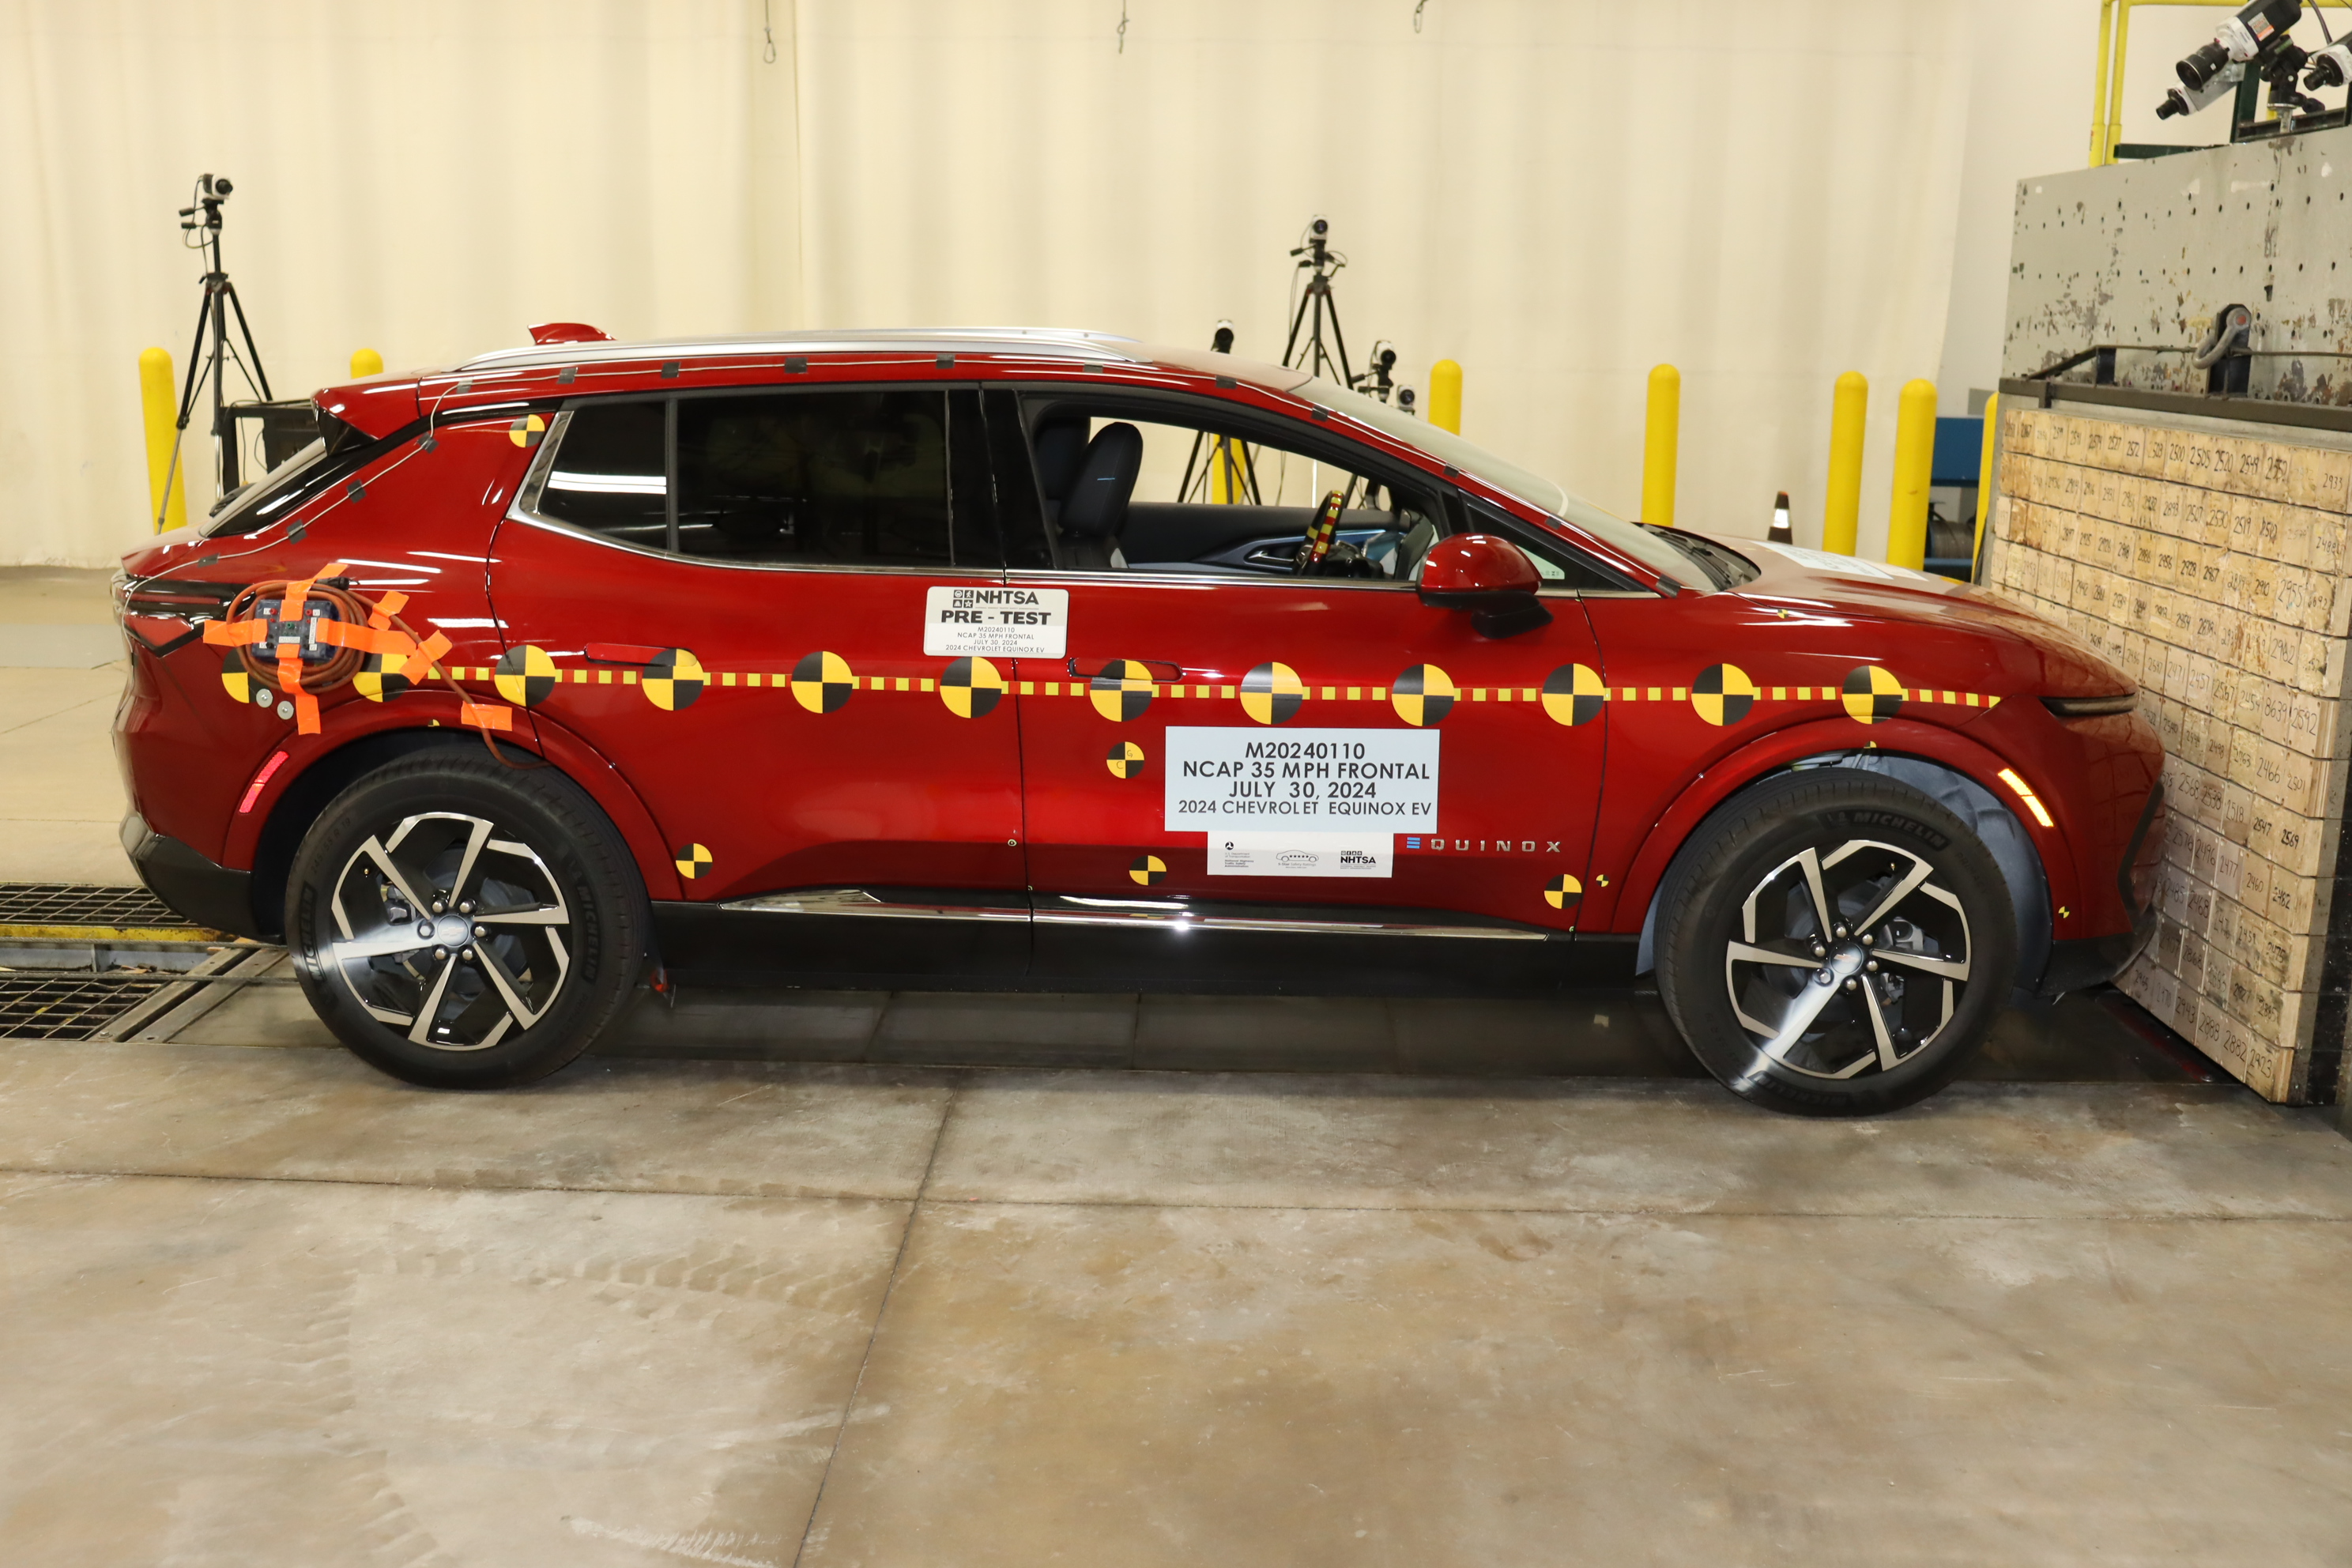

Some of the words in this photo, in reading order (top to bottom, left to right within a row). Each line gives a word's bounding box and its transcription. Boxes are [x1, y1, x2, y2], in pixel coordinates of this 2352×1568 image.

[2169, 443, 2186, 462] 2500
[2189, 446, 2211, 469] 2505
[2214, 449, 2233, 473] 2520
[2239, 453, 2260, 475] 2549
[2322, 473, 2343, 492] 2933
[2185, 504, 2203, 522] 2507
[2209, 508, 2229, 529] 2530
[2233, 515, 2252, 536] 2519
[2158, 552, 2173, 571] 2956
[2180, 559, 2197, 578] 2928
[975, 590, 1039, 605] NHTSA
[2278, 579, 2303, 609] 2955
[940, 610, 982, 624] PRE
[1000, 611, 1051, 625] TEST
[2166, 661, 2186, 684] 2471
[2188, 669, 2211, 693] 2457
[2212, 679, 2236, 704] 2567
[2263, 696, 2287, 724] 8639
[2290, 707, 2318, 737] 2592
[1245, 742, 1366, 760] M20240110
[1183, 761, 1244, 778] NCAP
[1250, 762, 1275, 778] 35
[1282, 763, 1330, 779] MPH
[1338, 763, 1430, 780] FRONTAL
[2256, 756, 2281, 784] 2466
[1228, 782, 1276, 798] JULY
[1289, 782, 1320, 800] 30,
[1328, 782, 1377, 799] 2024
[2178, 772, 2200, 801] 2568
[2286, 774, 2306, 794] 2501
[1178, 800, 1217, 814] 2024
[1222, 801, 1319, 815] CHEVROLET
[1329, 801, 1406, 816] EQUINOX
[1412, 802, 1432, 816] EV
[2201, 786, 2222, 811] 2538
[2226, 799, 2245, 824] 2518
[1853, 812, 1945, 846] MICHELIN
[2252, 816, 2273, 837] 2547
[2280, 827, 2300, 850] 2569
[1407, 836, 1562, 854] EQUINOX
[2173, 827, 2194, 852] 2576
[1340, 856, 1376, 865] NHTSA
[2195, 839, 2216, 866] 2496
[2219, 855, 2239, 879] 2477
[2164, 877, 2185, 904] 2485
[2246, 872, 2264, 893] 2460
[2188, 890, 2210, 919] 2468
[302, 887, 323, 981] MICHELIN
[578, 885, 600, 982] MICHELIN
[2182, 944, 2203, 971] 2868
[2176, 996, 2196, 1024] 2943
[2199, 1012, 2221, 1042] 2888
[2222, 1030, 2248, 1063] 2882
[2249, 1049, 2272, 1079] 2923
